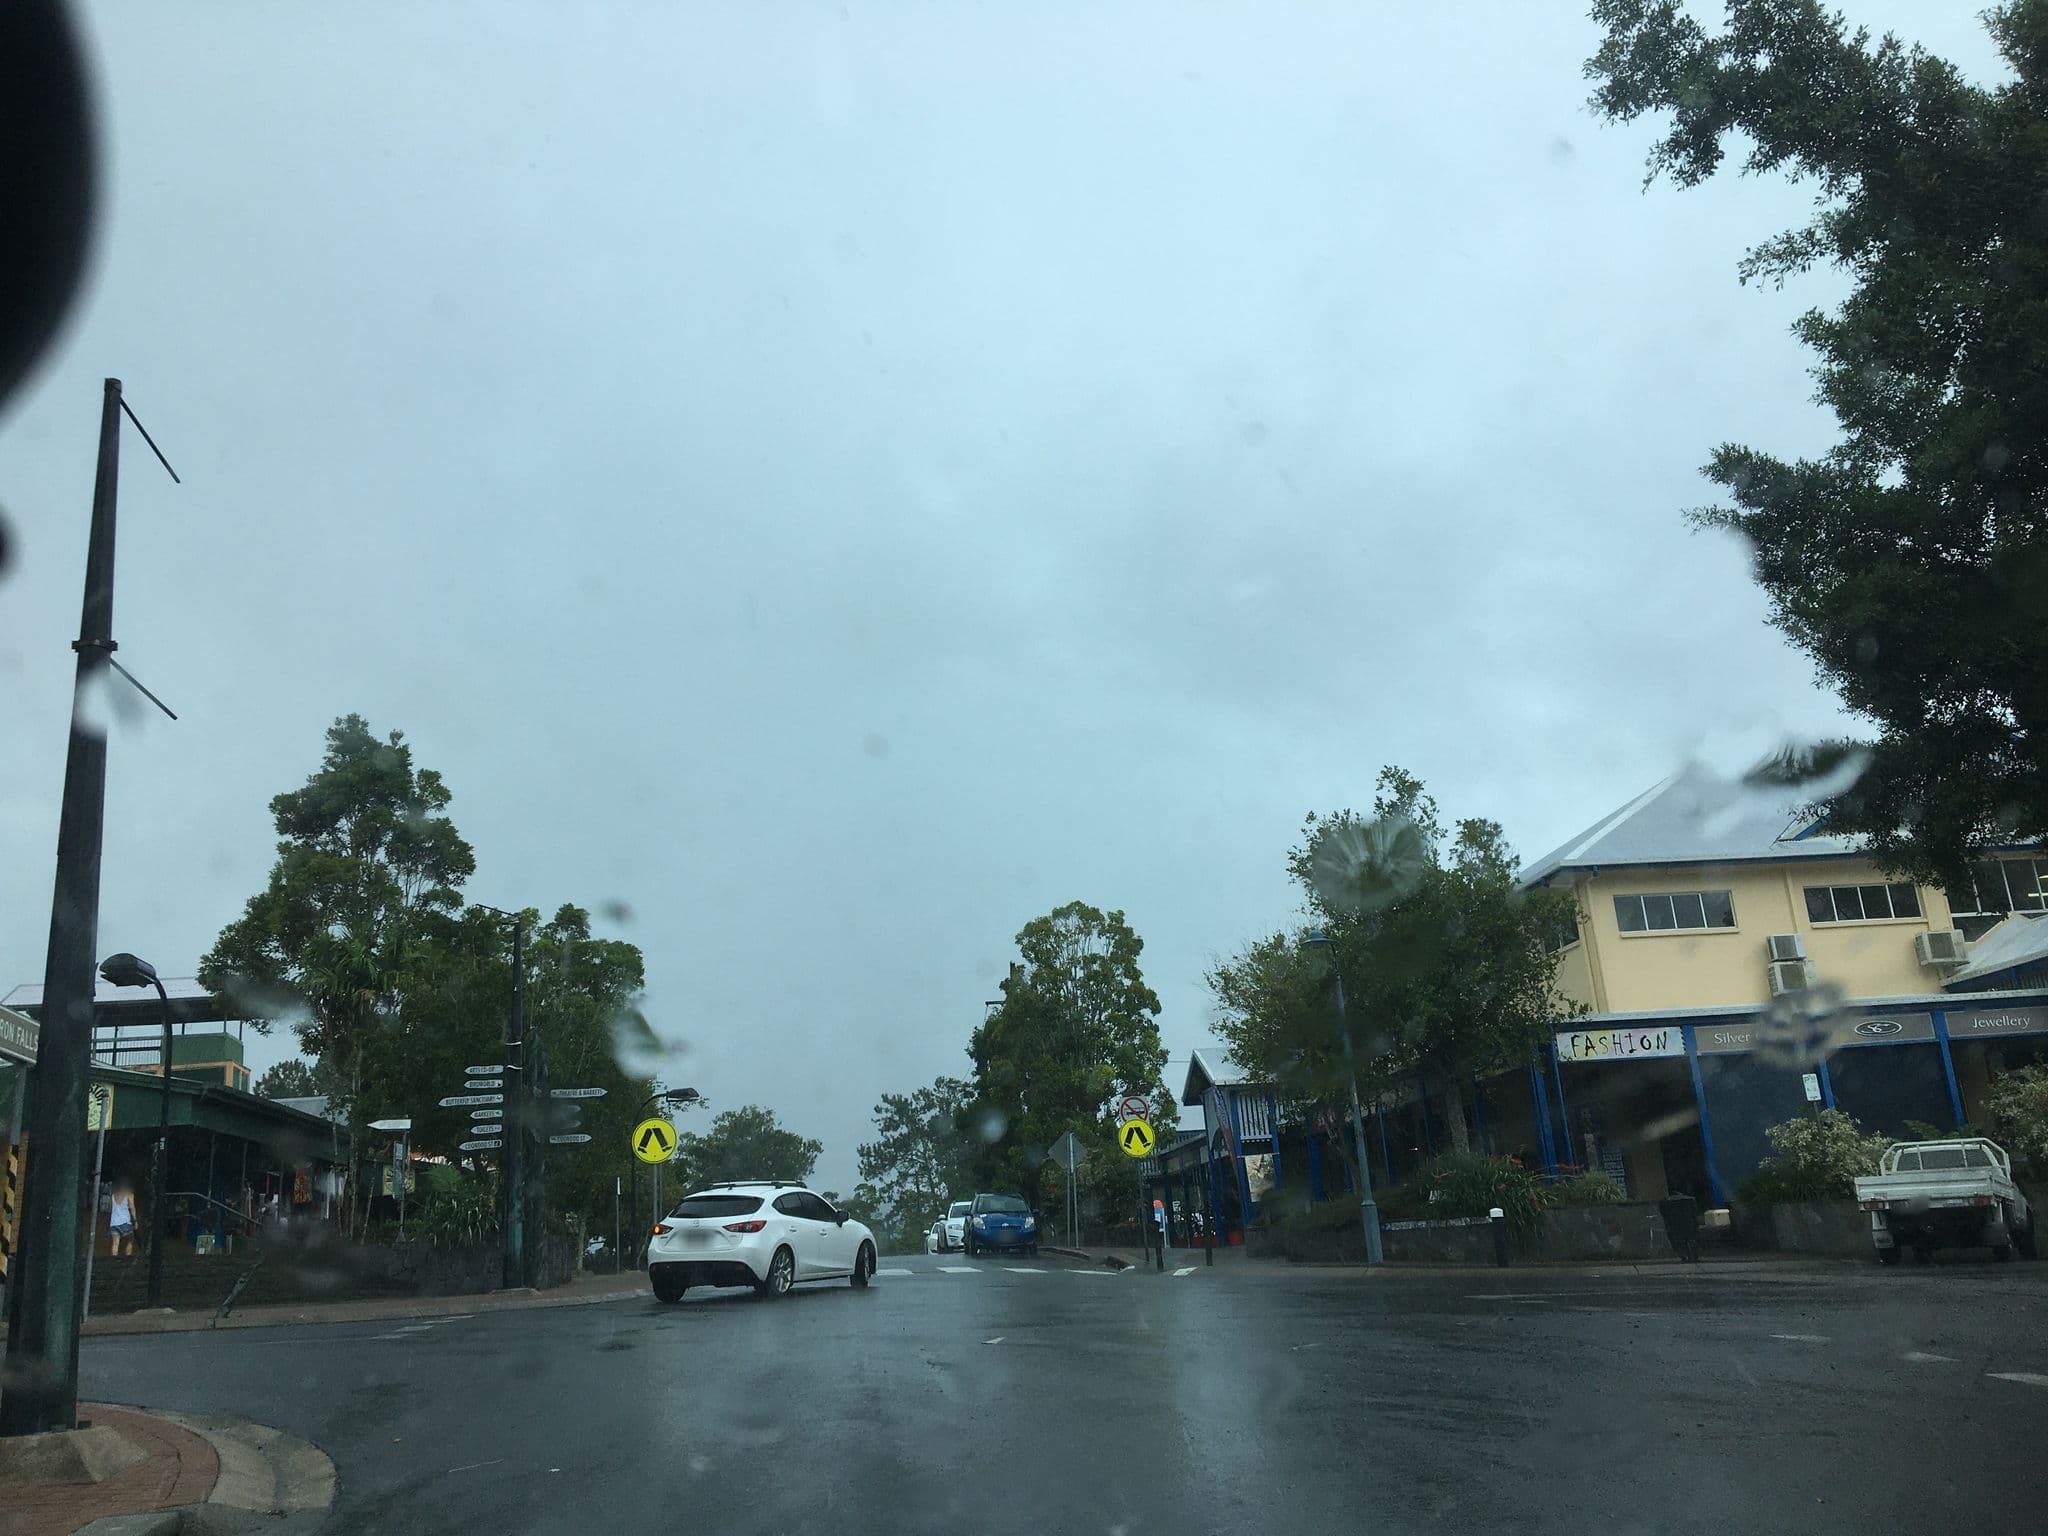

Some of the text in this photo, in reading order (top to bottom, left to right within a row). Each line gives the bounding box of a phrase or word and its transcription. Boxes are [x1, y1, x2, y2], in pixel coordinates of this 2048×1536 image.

[1972, 1014, 2031, 1029] Jewellery
[16, 1027, 39, 1052] FALLS
[1570, 1031, 1667, 1057] FASHION
[1714, 1031, 1751, 1045] Silver
